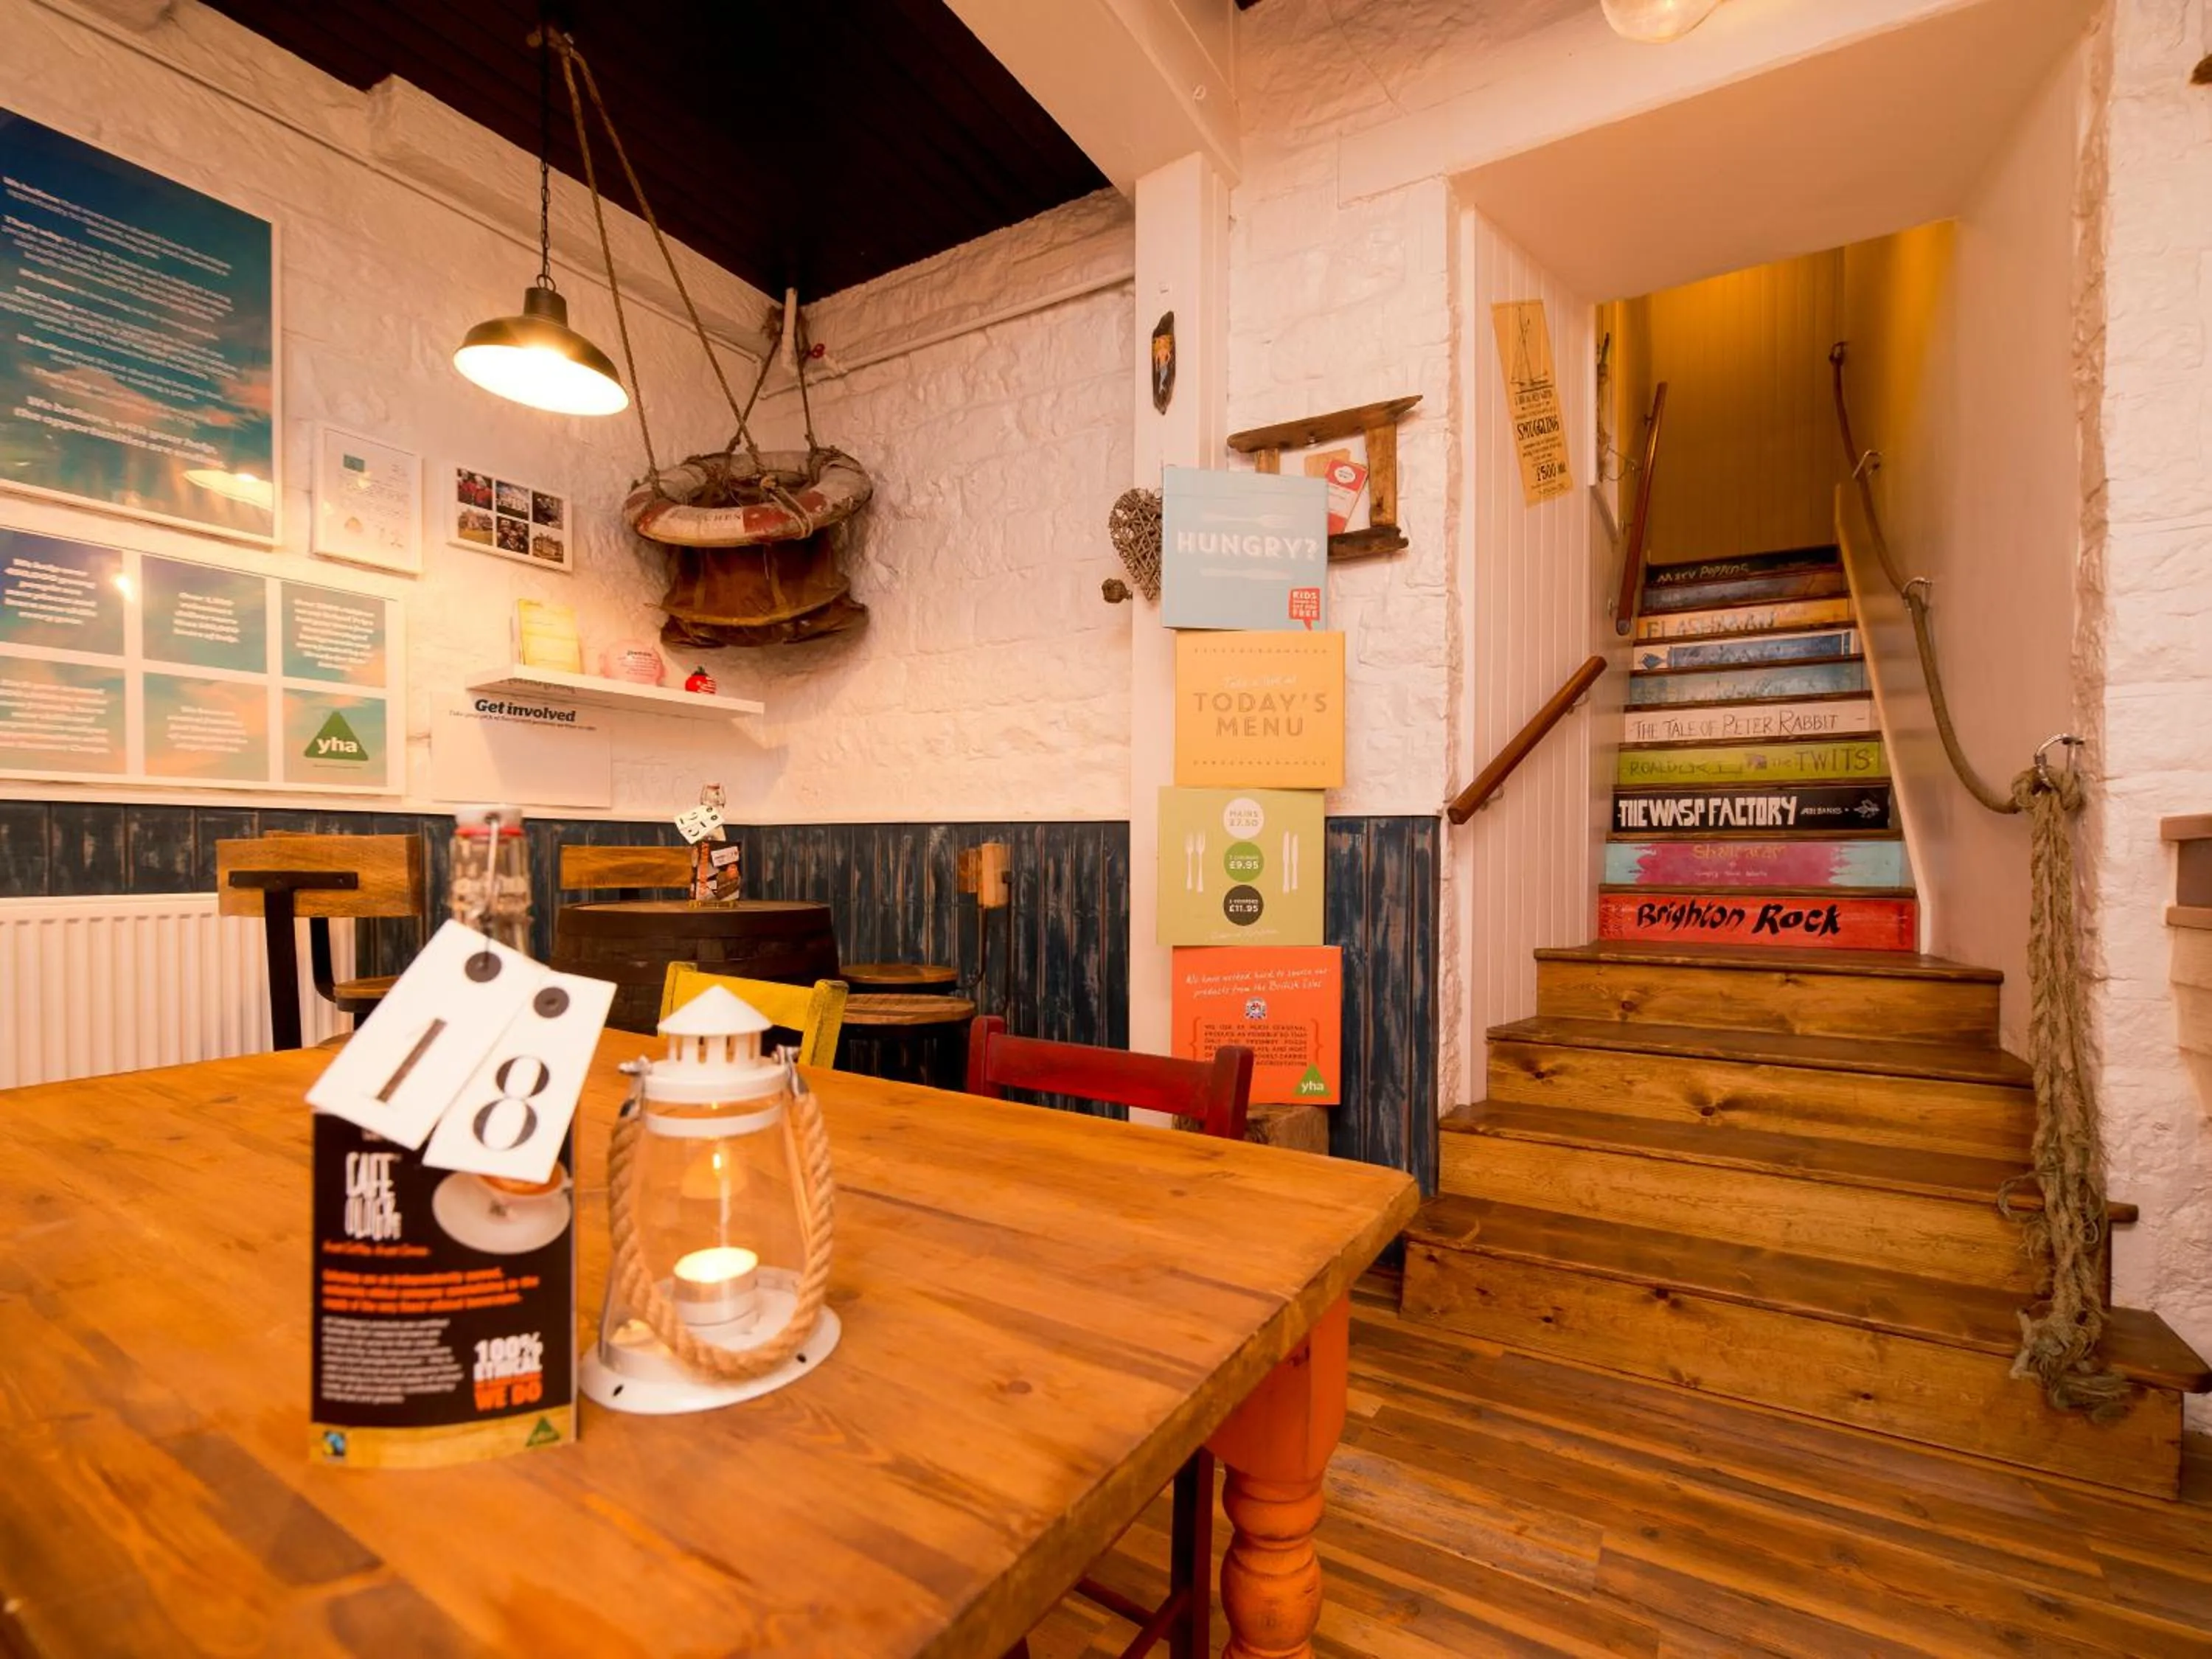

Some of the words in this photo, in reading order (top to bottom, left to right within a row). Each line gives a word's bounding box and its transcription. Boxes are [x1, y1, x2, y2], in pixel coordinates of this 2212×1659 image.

[1178, 532, 1320, 560] HUNGRY?
[475, 699, 506, 714] Get
[507, 702, 576, 722] involved
[1193, 692, 1327, 712] TODAY'S
[1217, 717, 1303, 737] MENU
[1635, 720, 1655, 740] THE
[1662, 718, 1694, 737] TALE
[1700, 720, 1718, 737] OF
[1722, 714, 1771, 737] PETER
[1778, 710, 1838, 736] RABBIT
[316, 737, 358, 754] yha
[1796, 748, 1871, 772] TWITS
[1618, 799, 1648, 827] THE
[1648, 799, 1705, 827] WASP
[1708, 796, 1797, 827] FACTORY
[1229, 860, 1259, 869] £9.95
[1636, 898, 1745, 933] Brighton
[1751, 903, 1842, 937] Rock
[361, 1018, 448, 1111] 1
[473, 1055, 550, 1152] 8
[1301, 1080, 1324, 1093] yha
[473, 1332, 543, 1364] 100%
[476, 1386, 507, 1412] WE
[511, 1380, 543, 1405] DO
